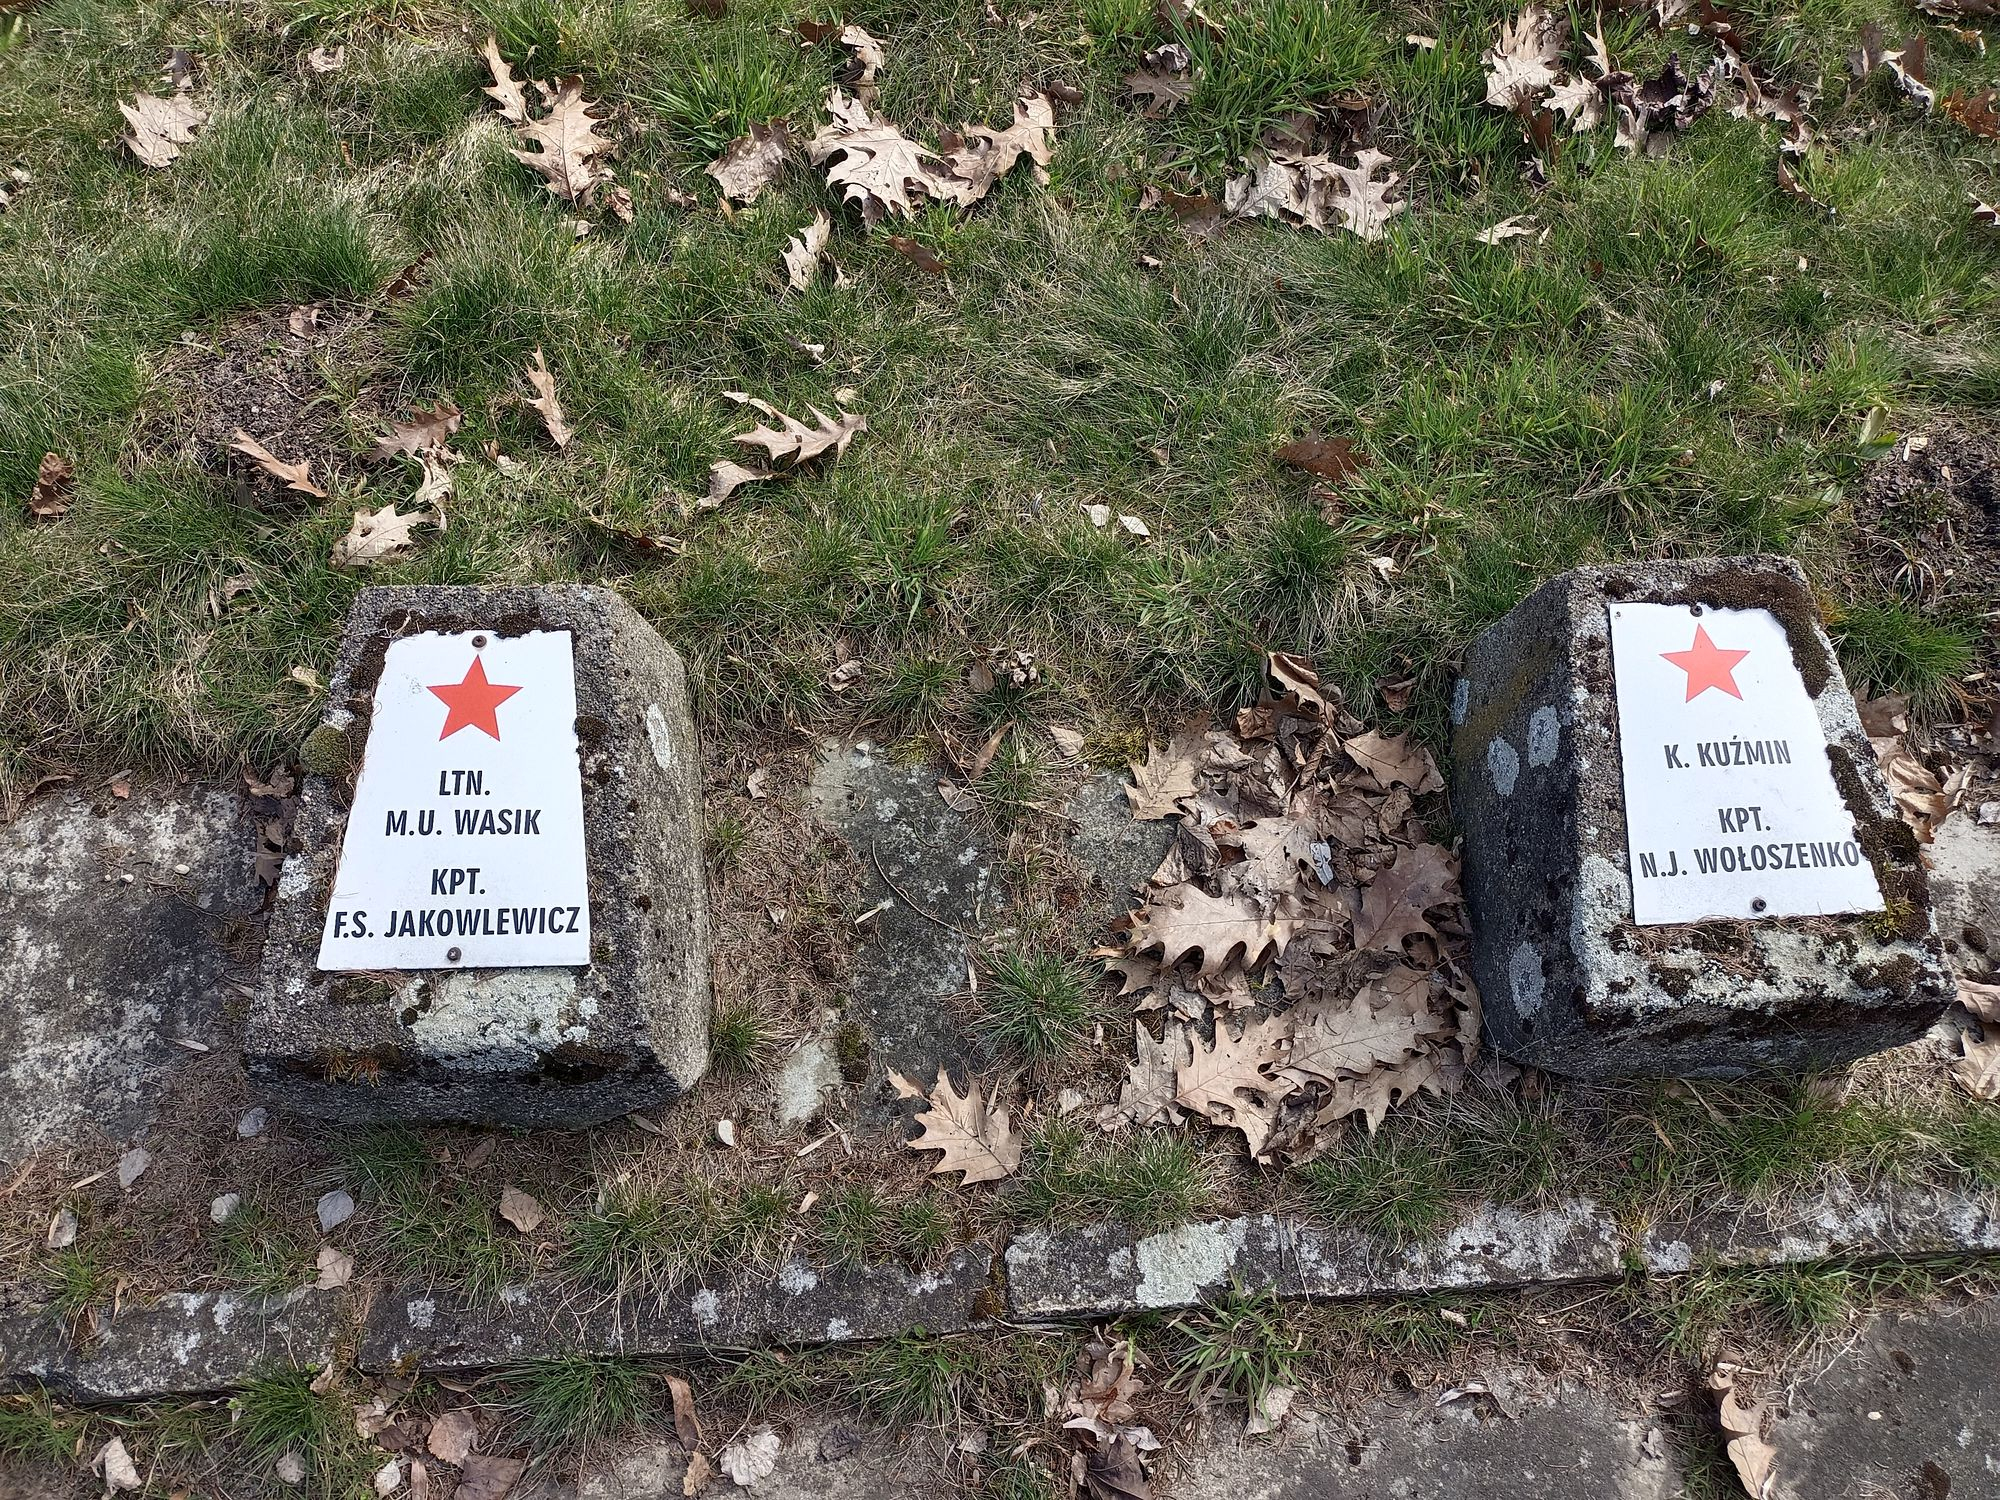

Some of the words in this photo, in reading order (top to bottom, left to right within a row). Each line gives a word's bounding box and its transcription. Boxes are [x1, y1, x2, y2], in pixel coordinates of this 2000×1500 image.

[1664, 744, 1689, 769] K.
[1697, 735, 1791, 767] KUŹMIN
[439, 770, 490, 796] LTN.
[385, 810, 442, 836] M.U.
[455, 809, 541, 835] WASIK
[1718, 807, 1771, 833] KPT.
[1639, 851, 1687, 878] N.J.
[1694, 841, 1860, 874] WOŁOSZENKO
[431, 868, 486, 895] KPT.
[334, 911, 373, 938] F.S.
[384, 907, 581, 938] JAKOWLEWICZ
